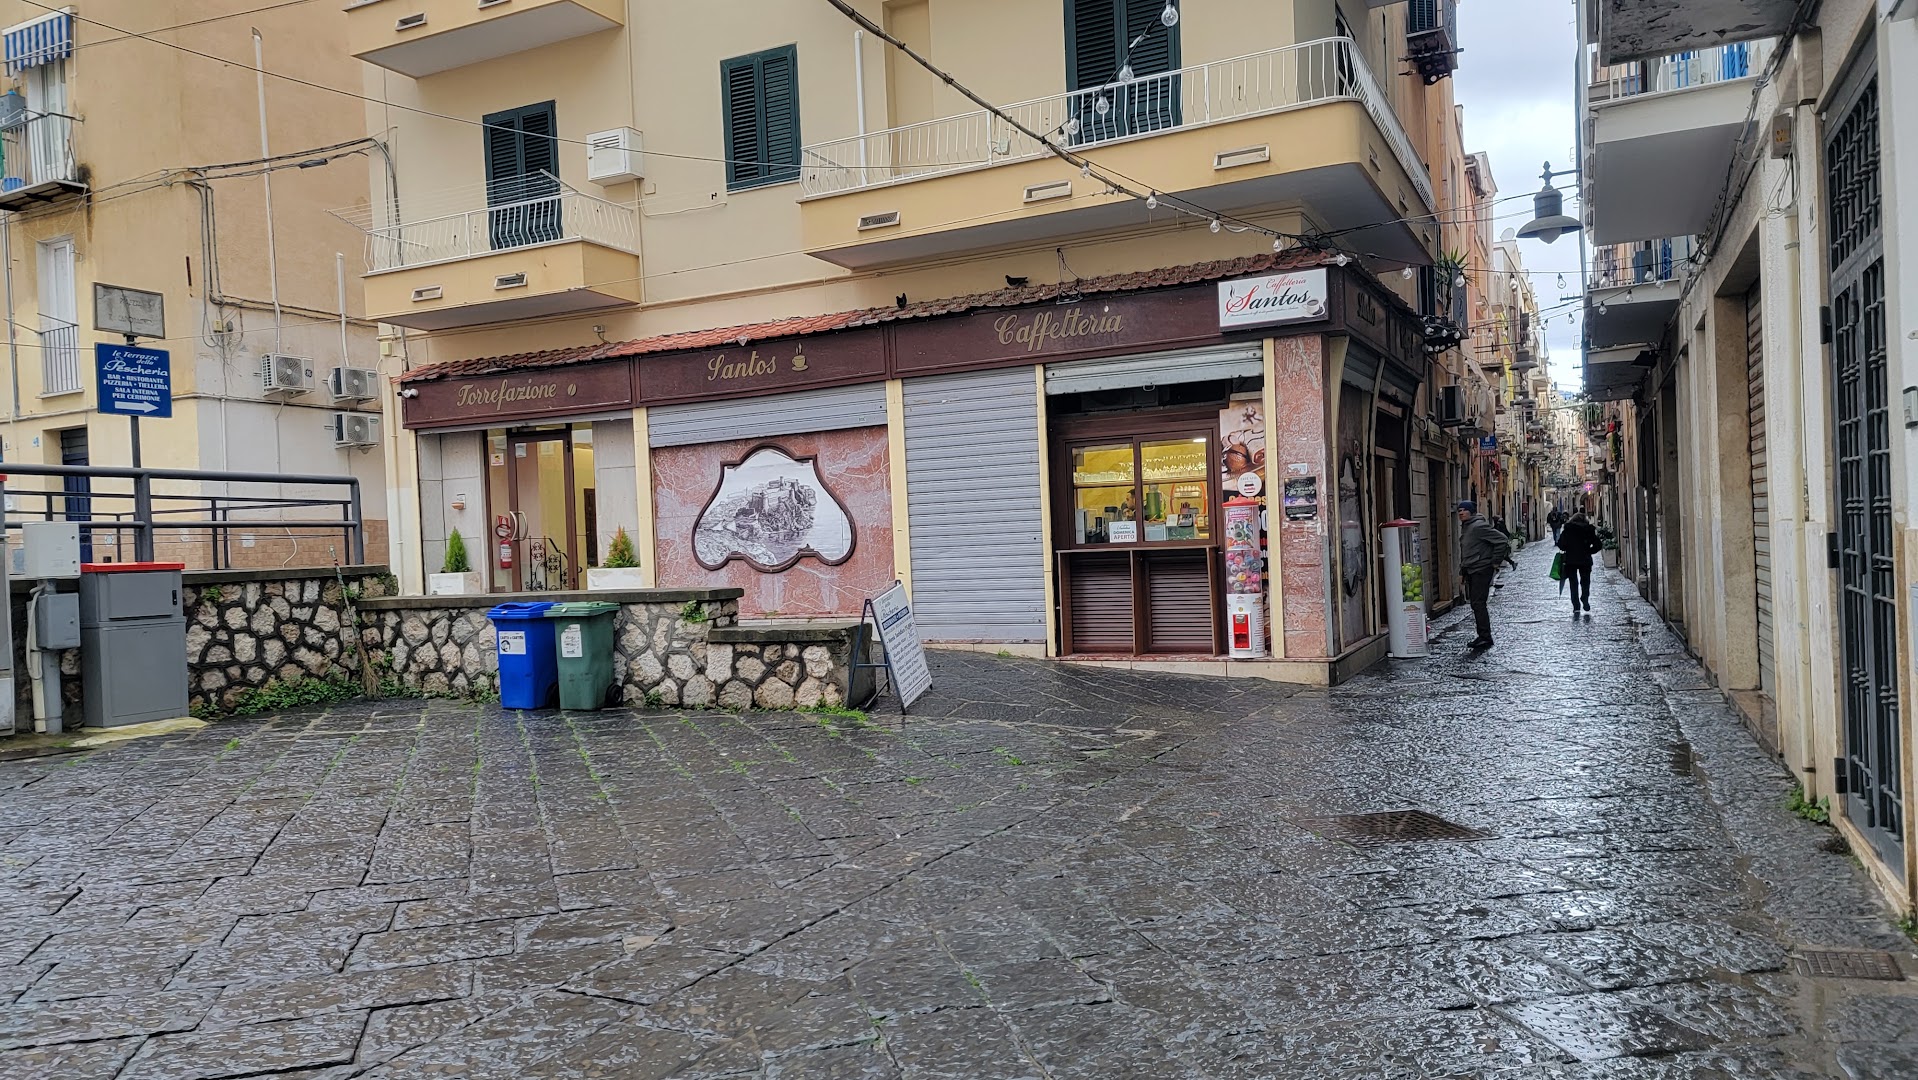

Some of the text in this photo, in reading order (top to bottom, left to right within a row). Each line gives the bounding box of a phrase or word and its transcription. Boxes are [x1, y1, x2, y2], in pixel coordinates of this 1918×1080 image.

[1266, 274, 1307, 295] Caffetteria
[1225, 285, 1311, 316] Santos
[994, 308, 1123, 351] Caffetteria
[103, 359, 168, 376] Pescheria
[123, 352, 159, 360] Terrazze
[707, 350, 776, 381] Santos
[126, 376, 164, 384] RISTORANTE
[457, 379, 557, 410] Torrefazione
